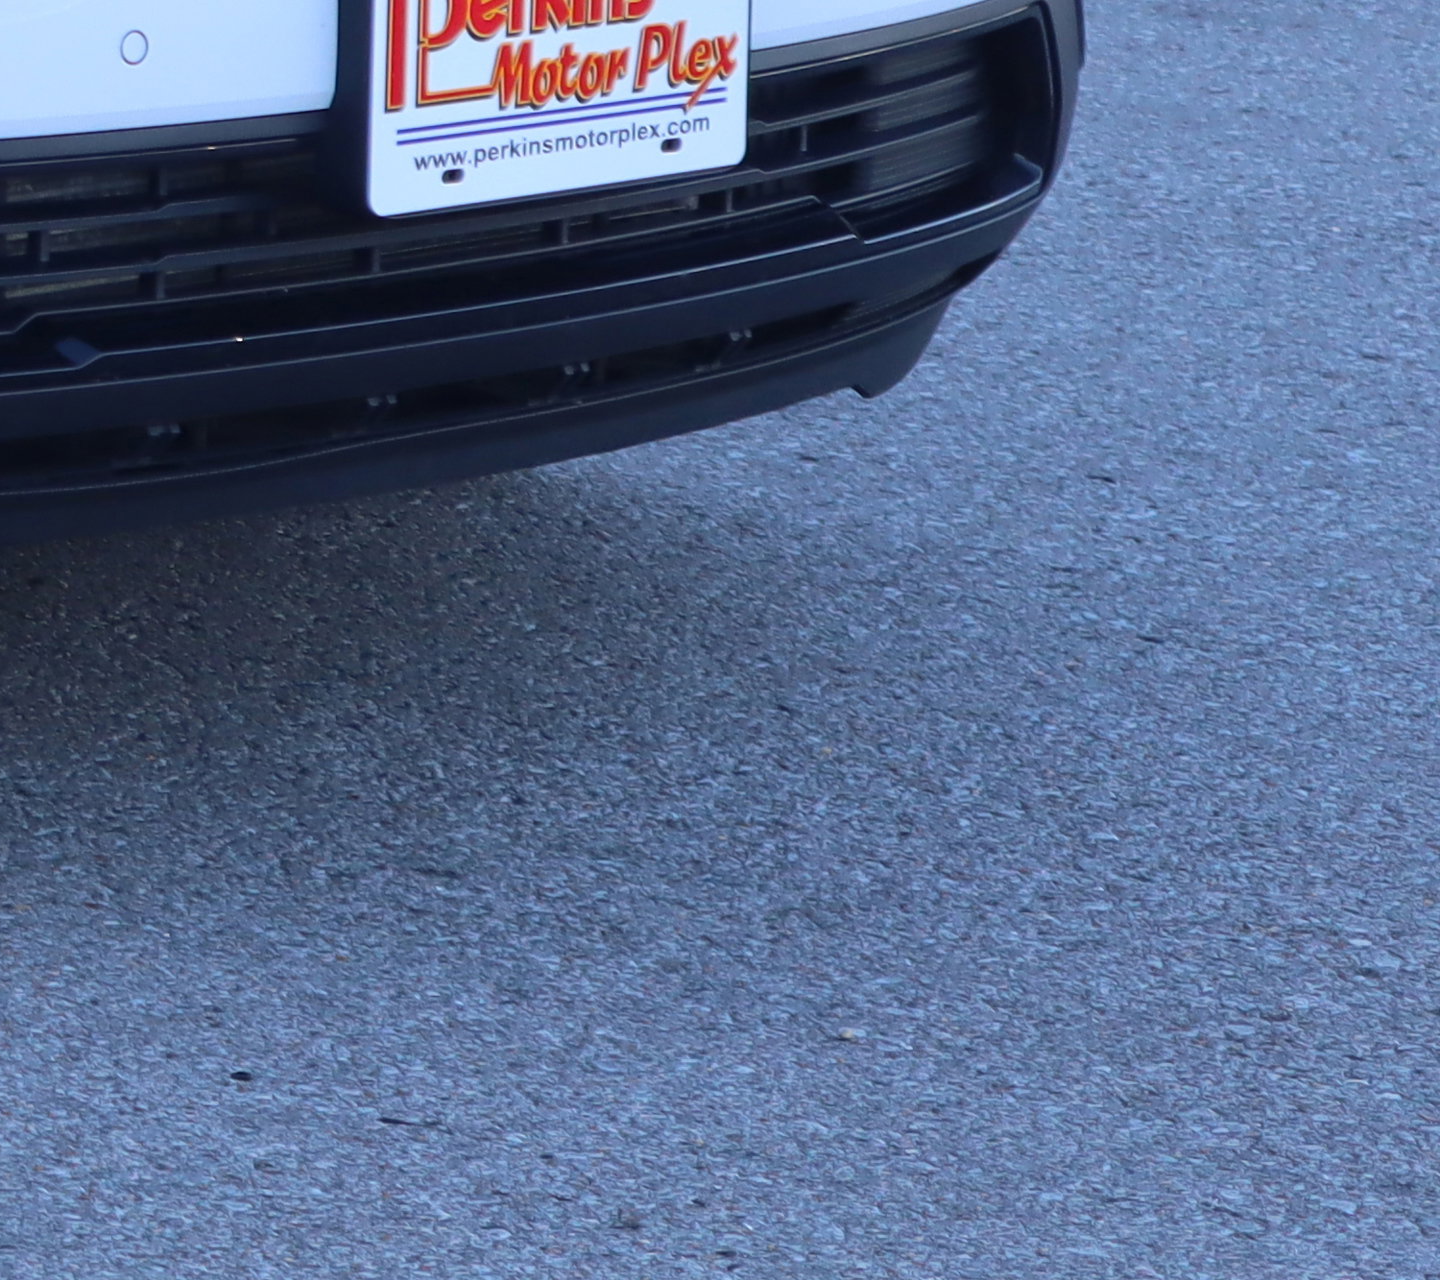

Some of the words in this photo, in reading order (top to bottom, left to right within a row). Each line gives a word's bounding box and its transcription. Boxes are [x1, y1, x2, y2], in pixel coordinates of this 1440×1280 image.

[492, 39, 631, 111] Motor
[633, 20, 740, 113] Plex
[414, 114, 711, 171] www.perkinsmotorplex.com
